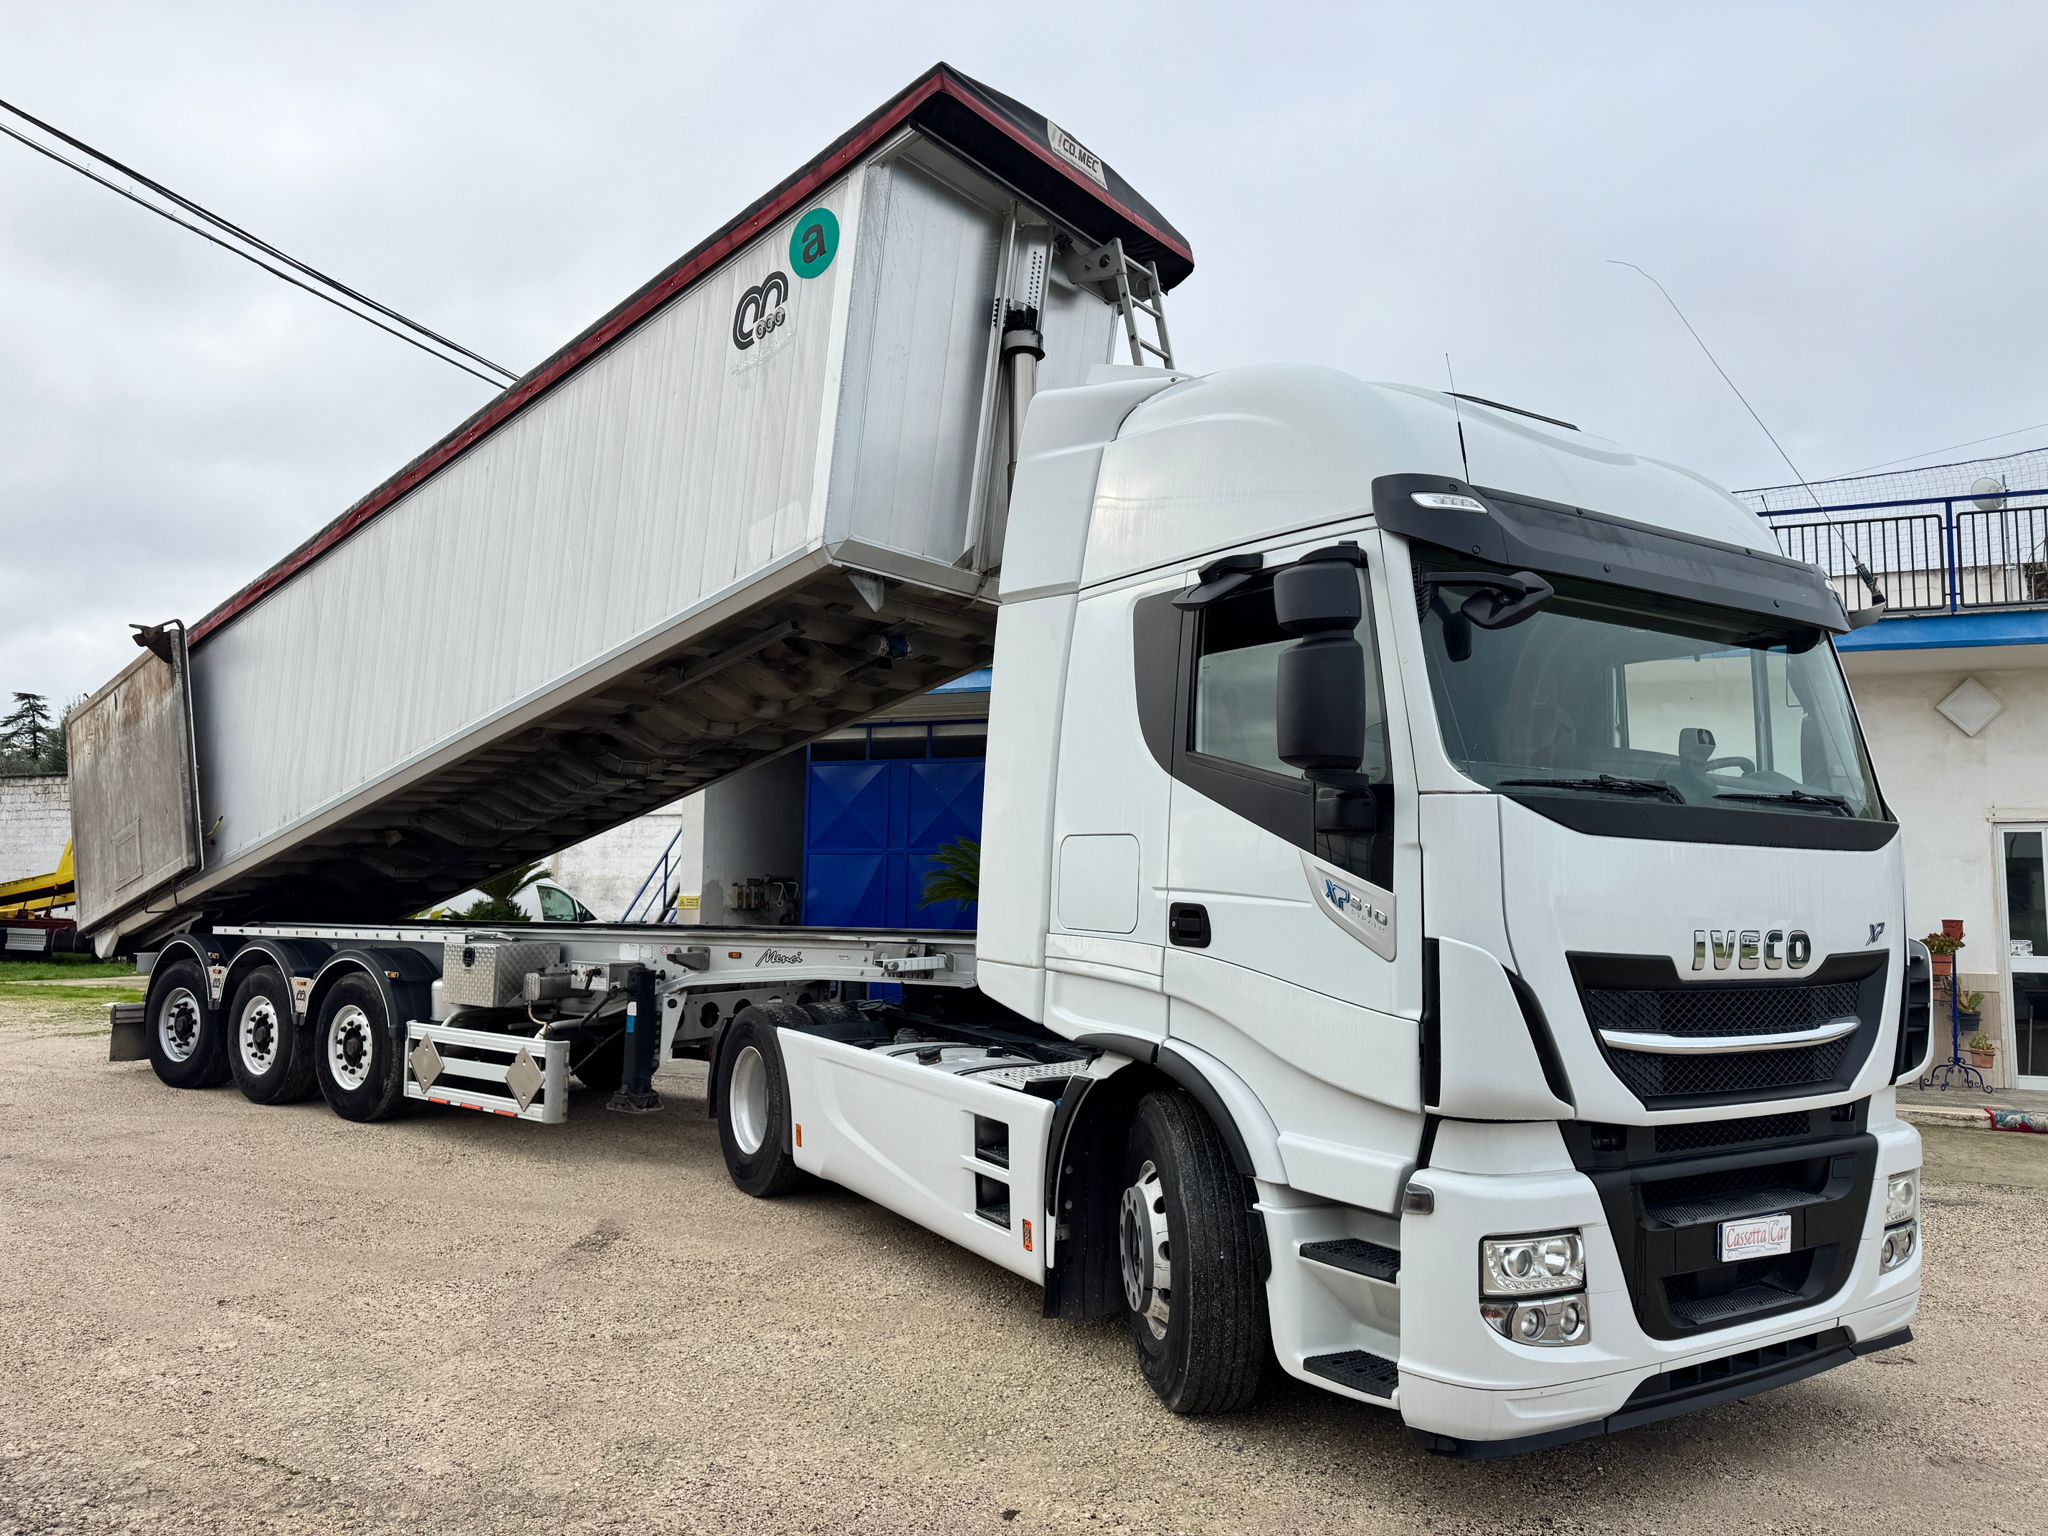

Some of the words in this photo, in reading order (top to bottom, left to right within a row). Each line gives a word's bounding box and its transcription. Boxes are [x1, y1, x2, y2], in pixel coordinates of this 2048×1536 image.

[802, 223, 827, 264] a
[1350, 893, 1388, 926] 510
[1692, 929, 1812, 970] IVECO
[1726, 1227, 1767, 1248] Cassetta
[1769, 1222, 1790, 1242] Car
